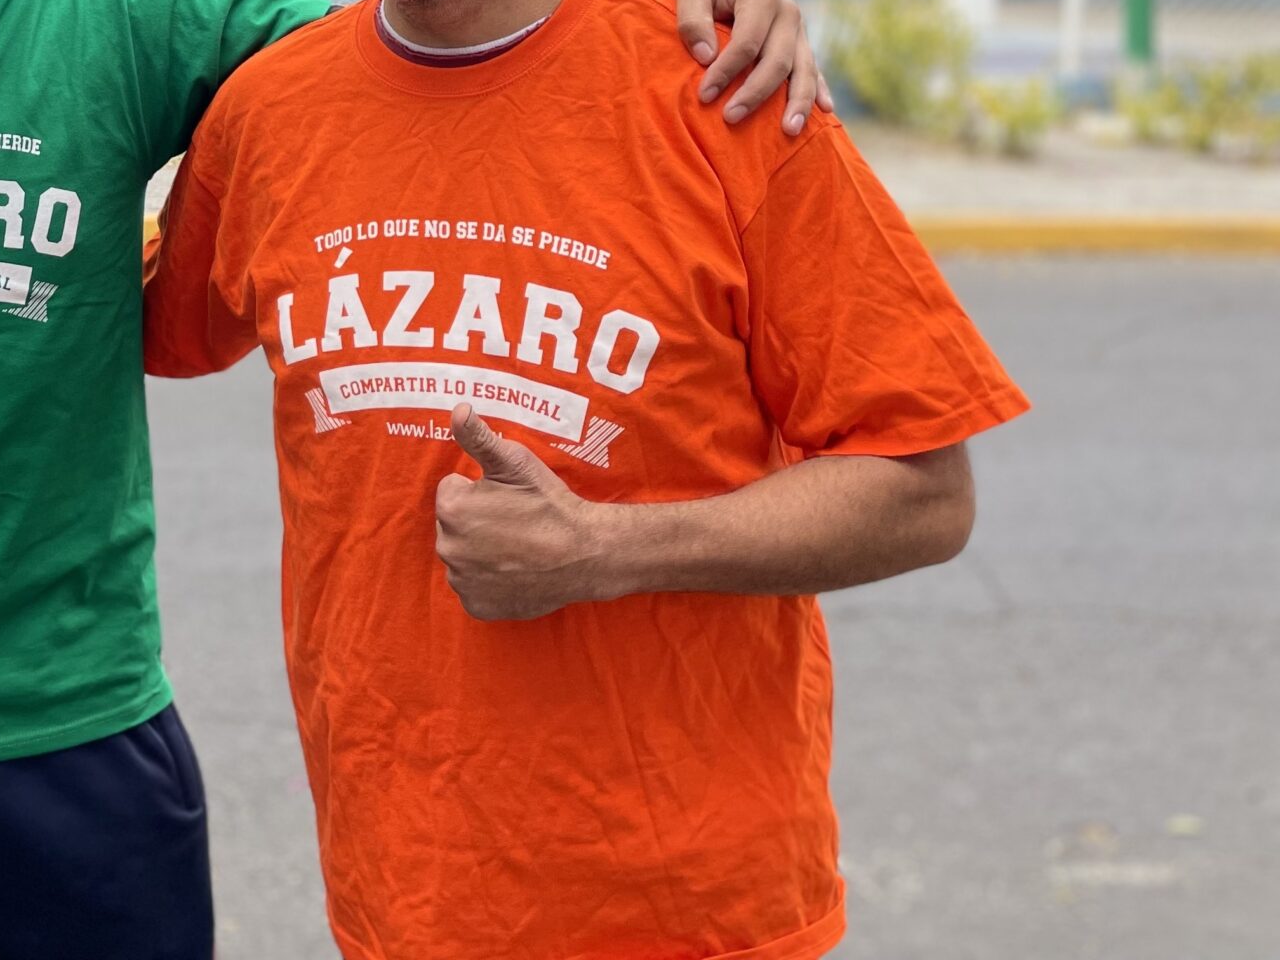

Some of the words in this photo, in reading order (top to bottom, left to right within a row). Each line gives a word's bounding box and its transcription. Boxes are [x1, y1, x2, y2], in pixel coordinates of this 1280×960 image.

[314, 225, 353, 253] TODO
[356, 221, 379, 241] LO
[383, 218, 420, 238] QUE
[424, 219, 451, 239] NO
[455, 221, 478, 240] SE
[482, 223, 506, 243] DA
[511, 226, 536, 247] SE
[538, 231, 611, 270] PIERDE
[276, 246, 661, 395] LÁZARO
[339, 377, 438, 399] COMPARTIR
[443, 378, 467, 396] LO
[471, 381, 561, 422] ESENCIAL
